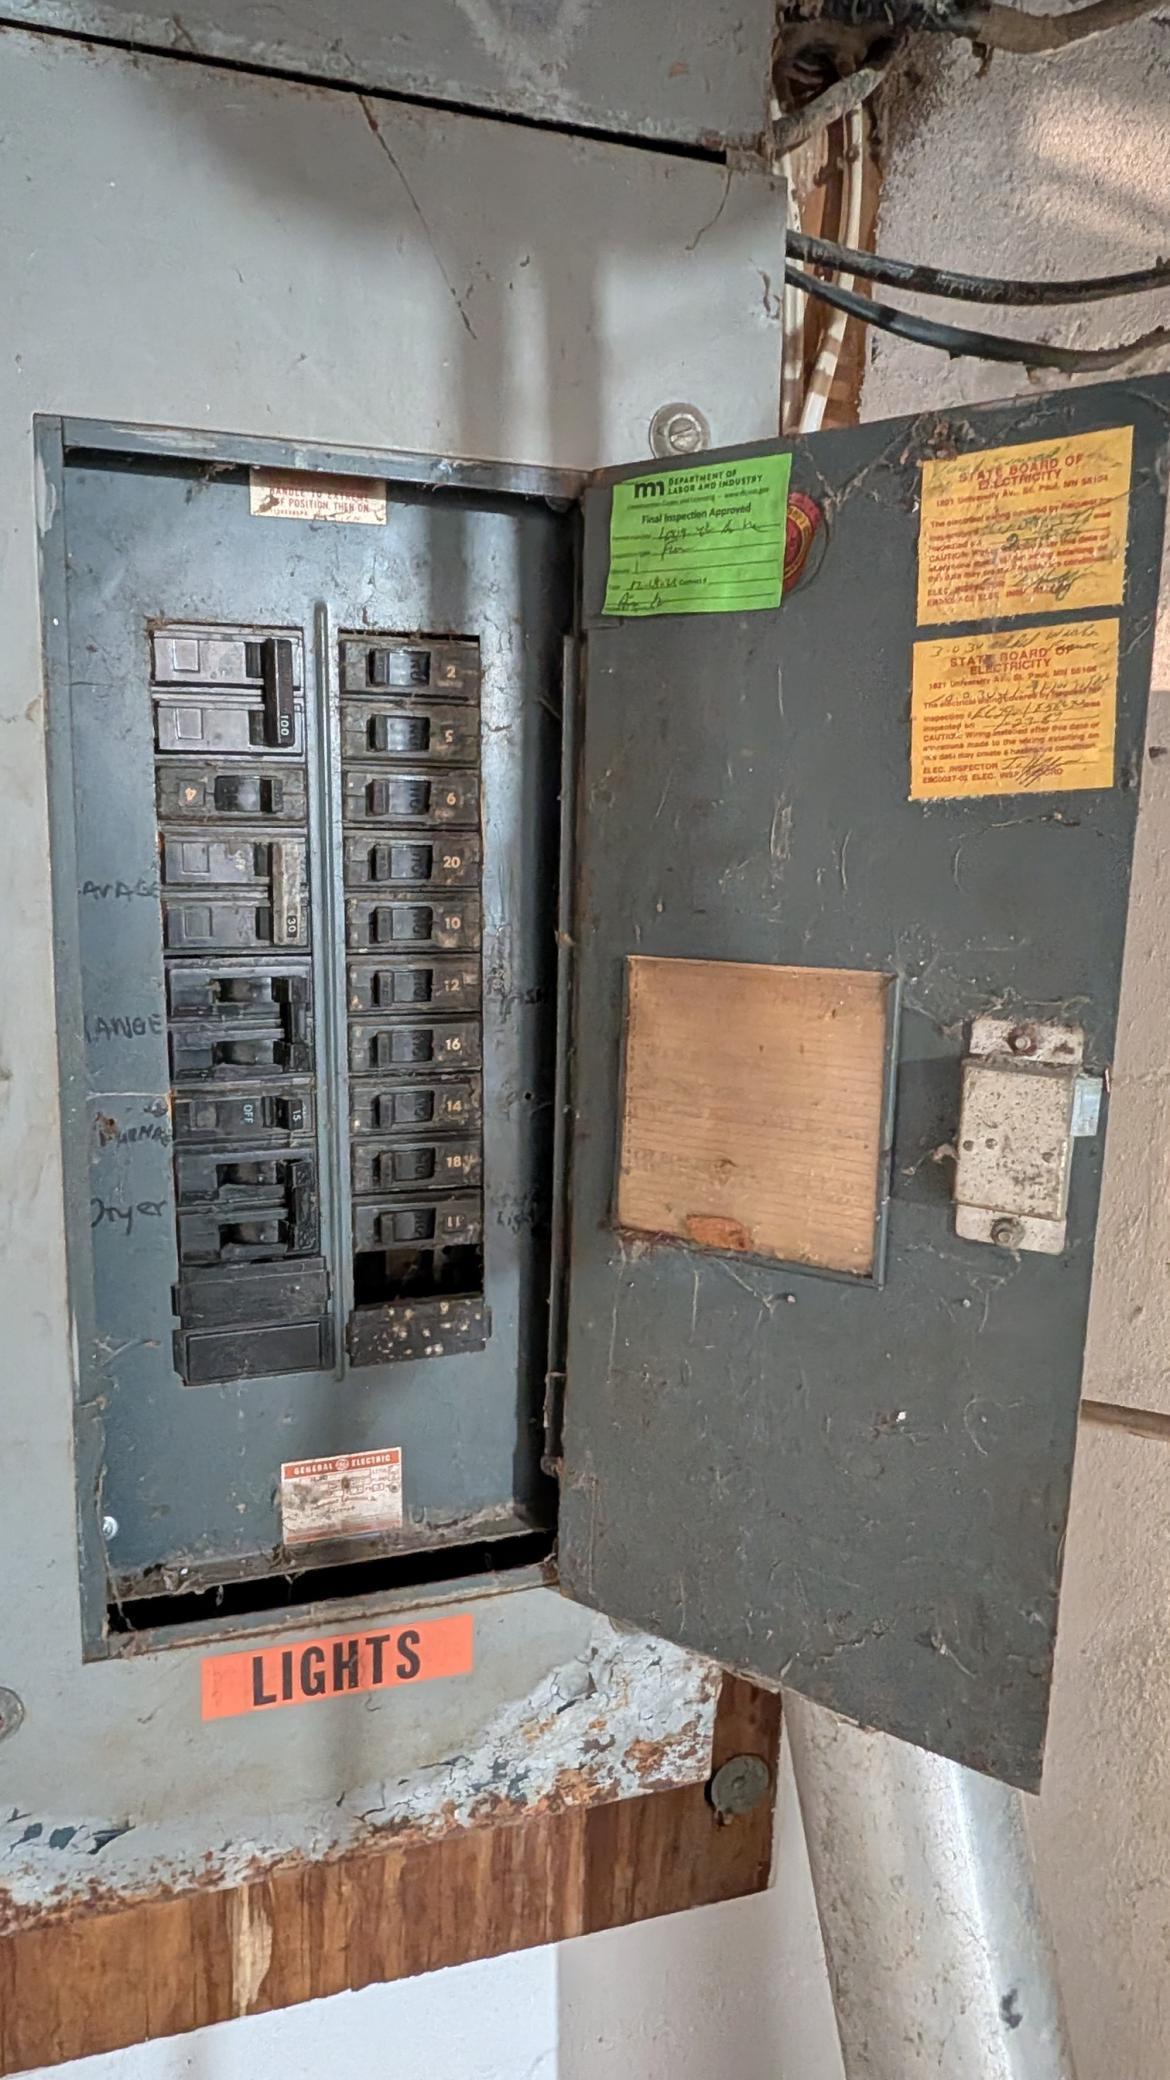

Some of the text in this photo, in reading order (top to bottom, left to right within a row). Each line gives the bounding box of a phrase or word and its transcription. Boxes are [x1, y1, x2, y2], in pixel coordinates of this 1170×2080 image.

[1065, 453, 1084, 467] OF
[669, 469, 737, 485] DEPARTMENT OF
[668, 475, 763, 495] LABOR AND INDUSTRY
[288, 499, 329, 510] POSITION
[358, 504, 370, 513] ON
[642, 514, 662, 524] Final
[664, 509, 708, 523] Inspection
[709, 502, 751, 518] Approved
[1000, 648, 1048, 662] BOARD
[446, 665, 456, 679] 2
[970, 659, 1051, 675] ELECTRICITY
[280, 715, 290, 736] 100
[444, 730, 454, 743] 5
[446, 791, 456, 805] 6
[442, 856, 461, 868] 20
[287, 917, 297, 933] 30
[444, 917, 461, 929] 10
[445, 1037, 461, 1050] 16
[447, 1100, 462, 1112] 14
[243, 1104, 253, 1124] OFF
[292, 1109, 302, 1121] 15
[446, 1156, 461, 1168] 18
[294, 1463, 333, 1475] GENERAL
[352, 1454, 392, 1468] ELECTRIC
[252, 1630, 421, 1707] LIGHTS
